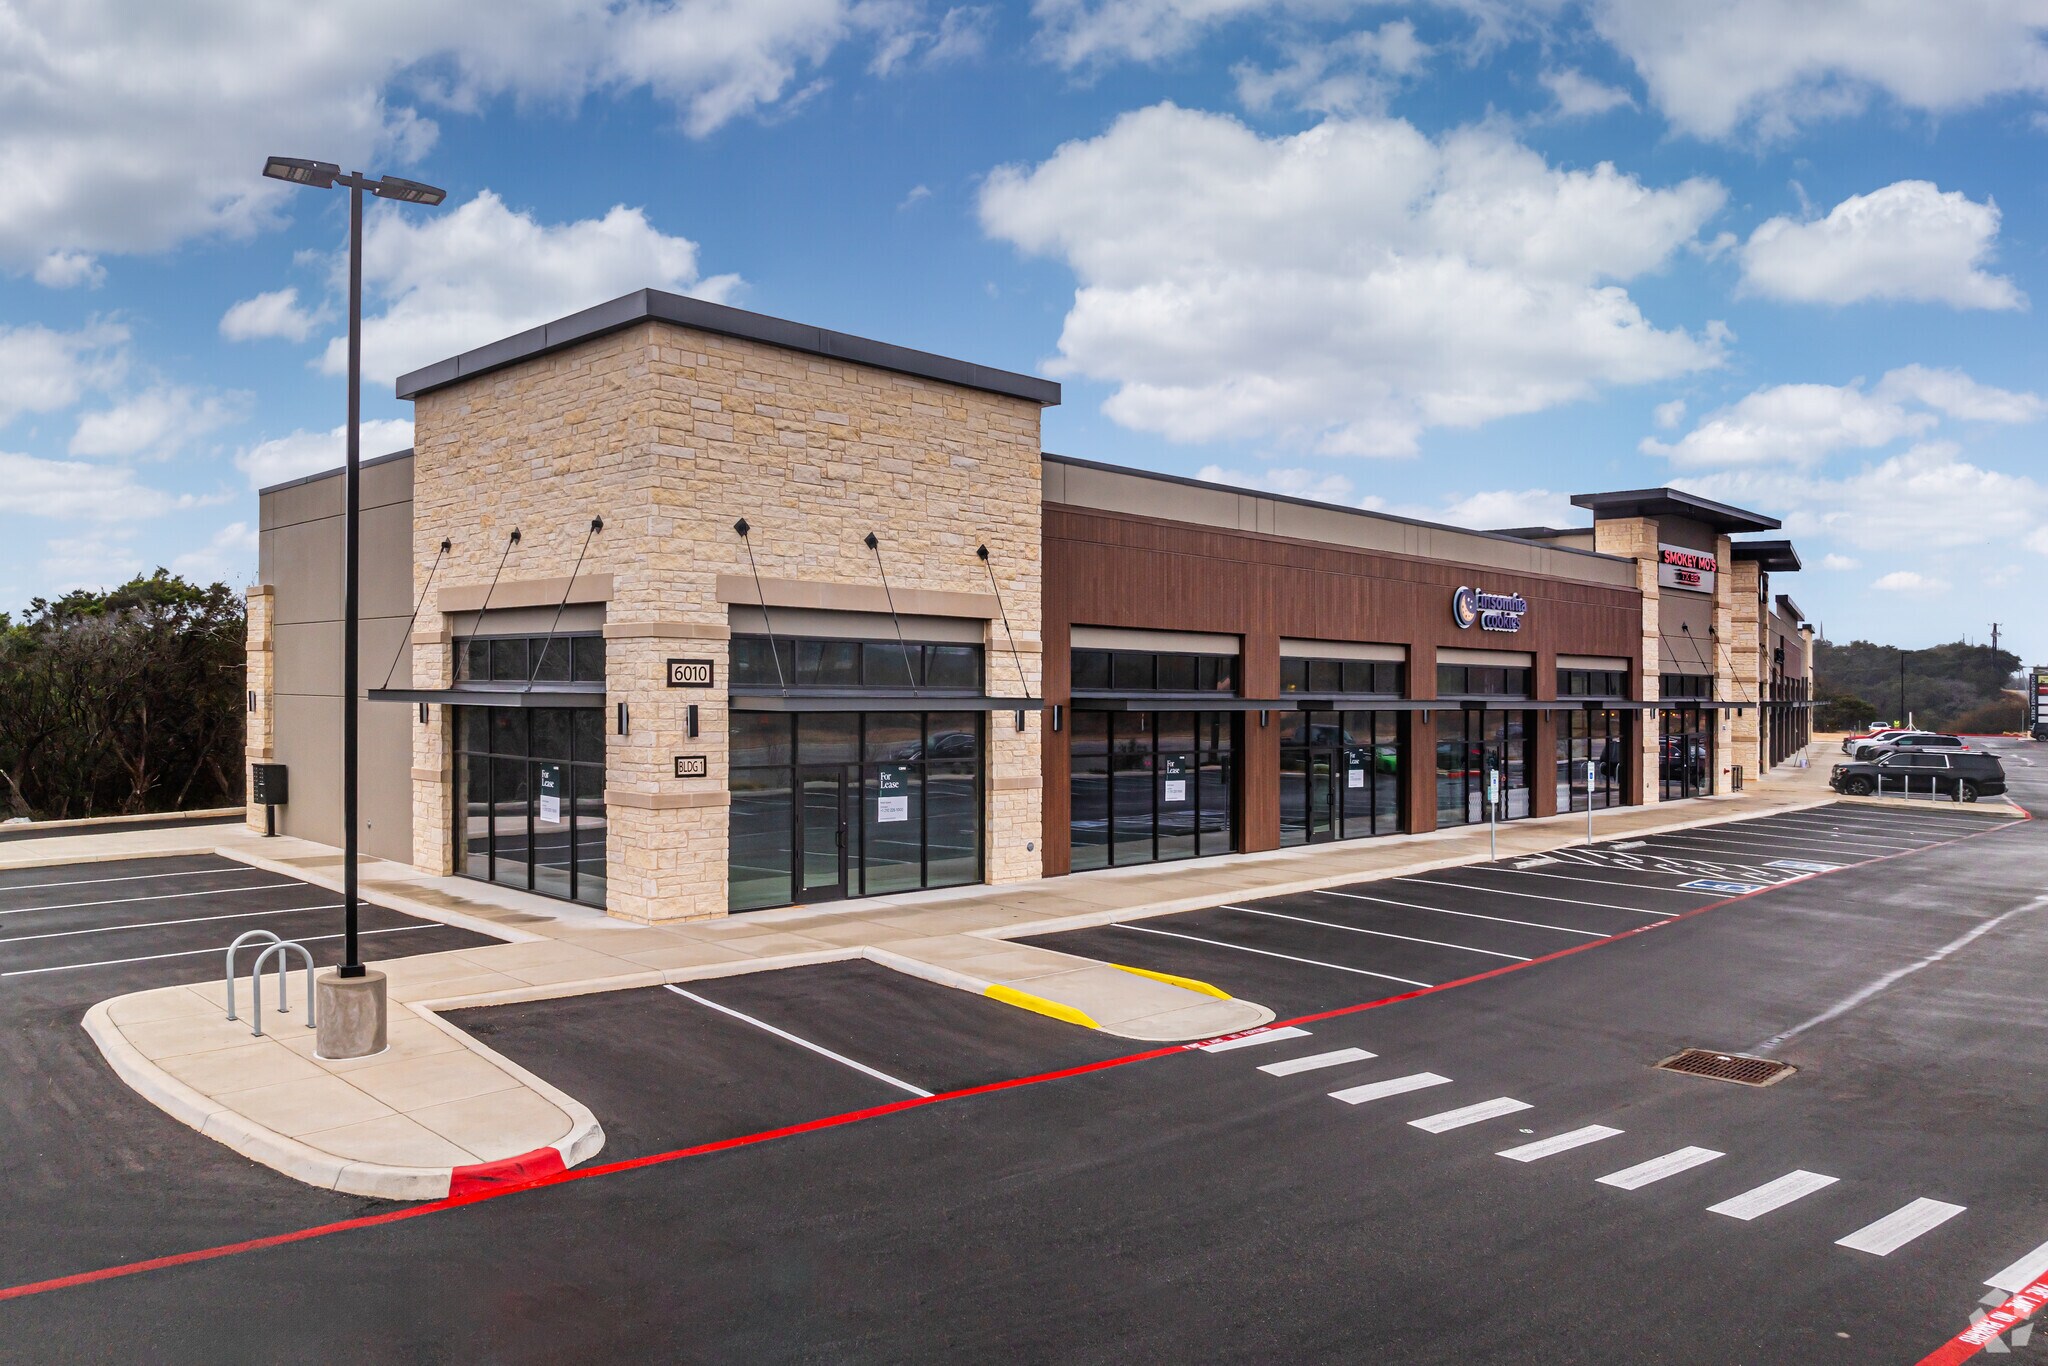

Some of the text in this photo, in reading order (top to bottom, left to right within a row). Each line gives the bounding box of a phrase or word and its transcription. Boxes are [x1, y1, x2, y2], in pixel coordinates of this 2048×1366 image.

[1664, 549, 1717, 572] SMOKEY MO'S
[674, 665, 707, 682] 6010
[679, 760, 698, 773] BLDG
[541, 769, 549, 779] For
[880, 772, 892, 781] For
[880, 780, 900, 789] Lease
